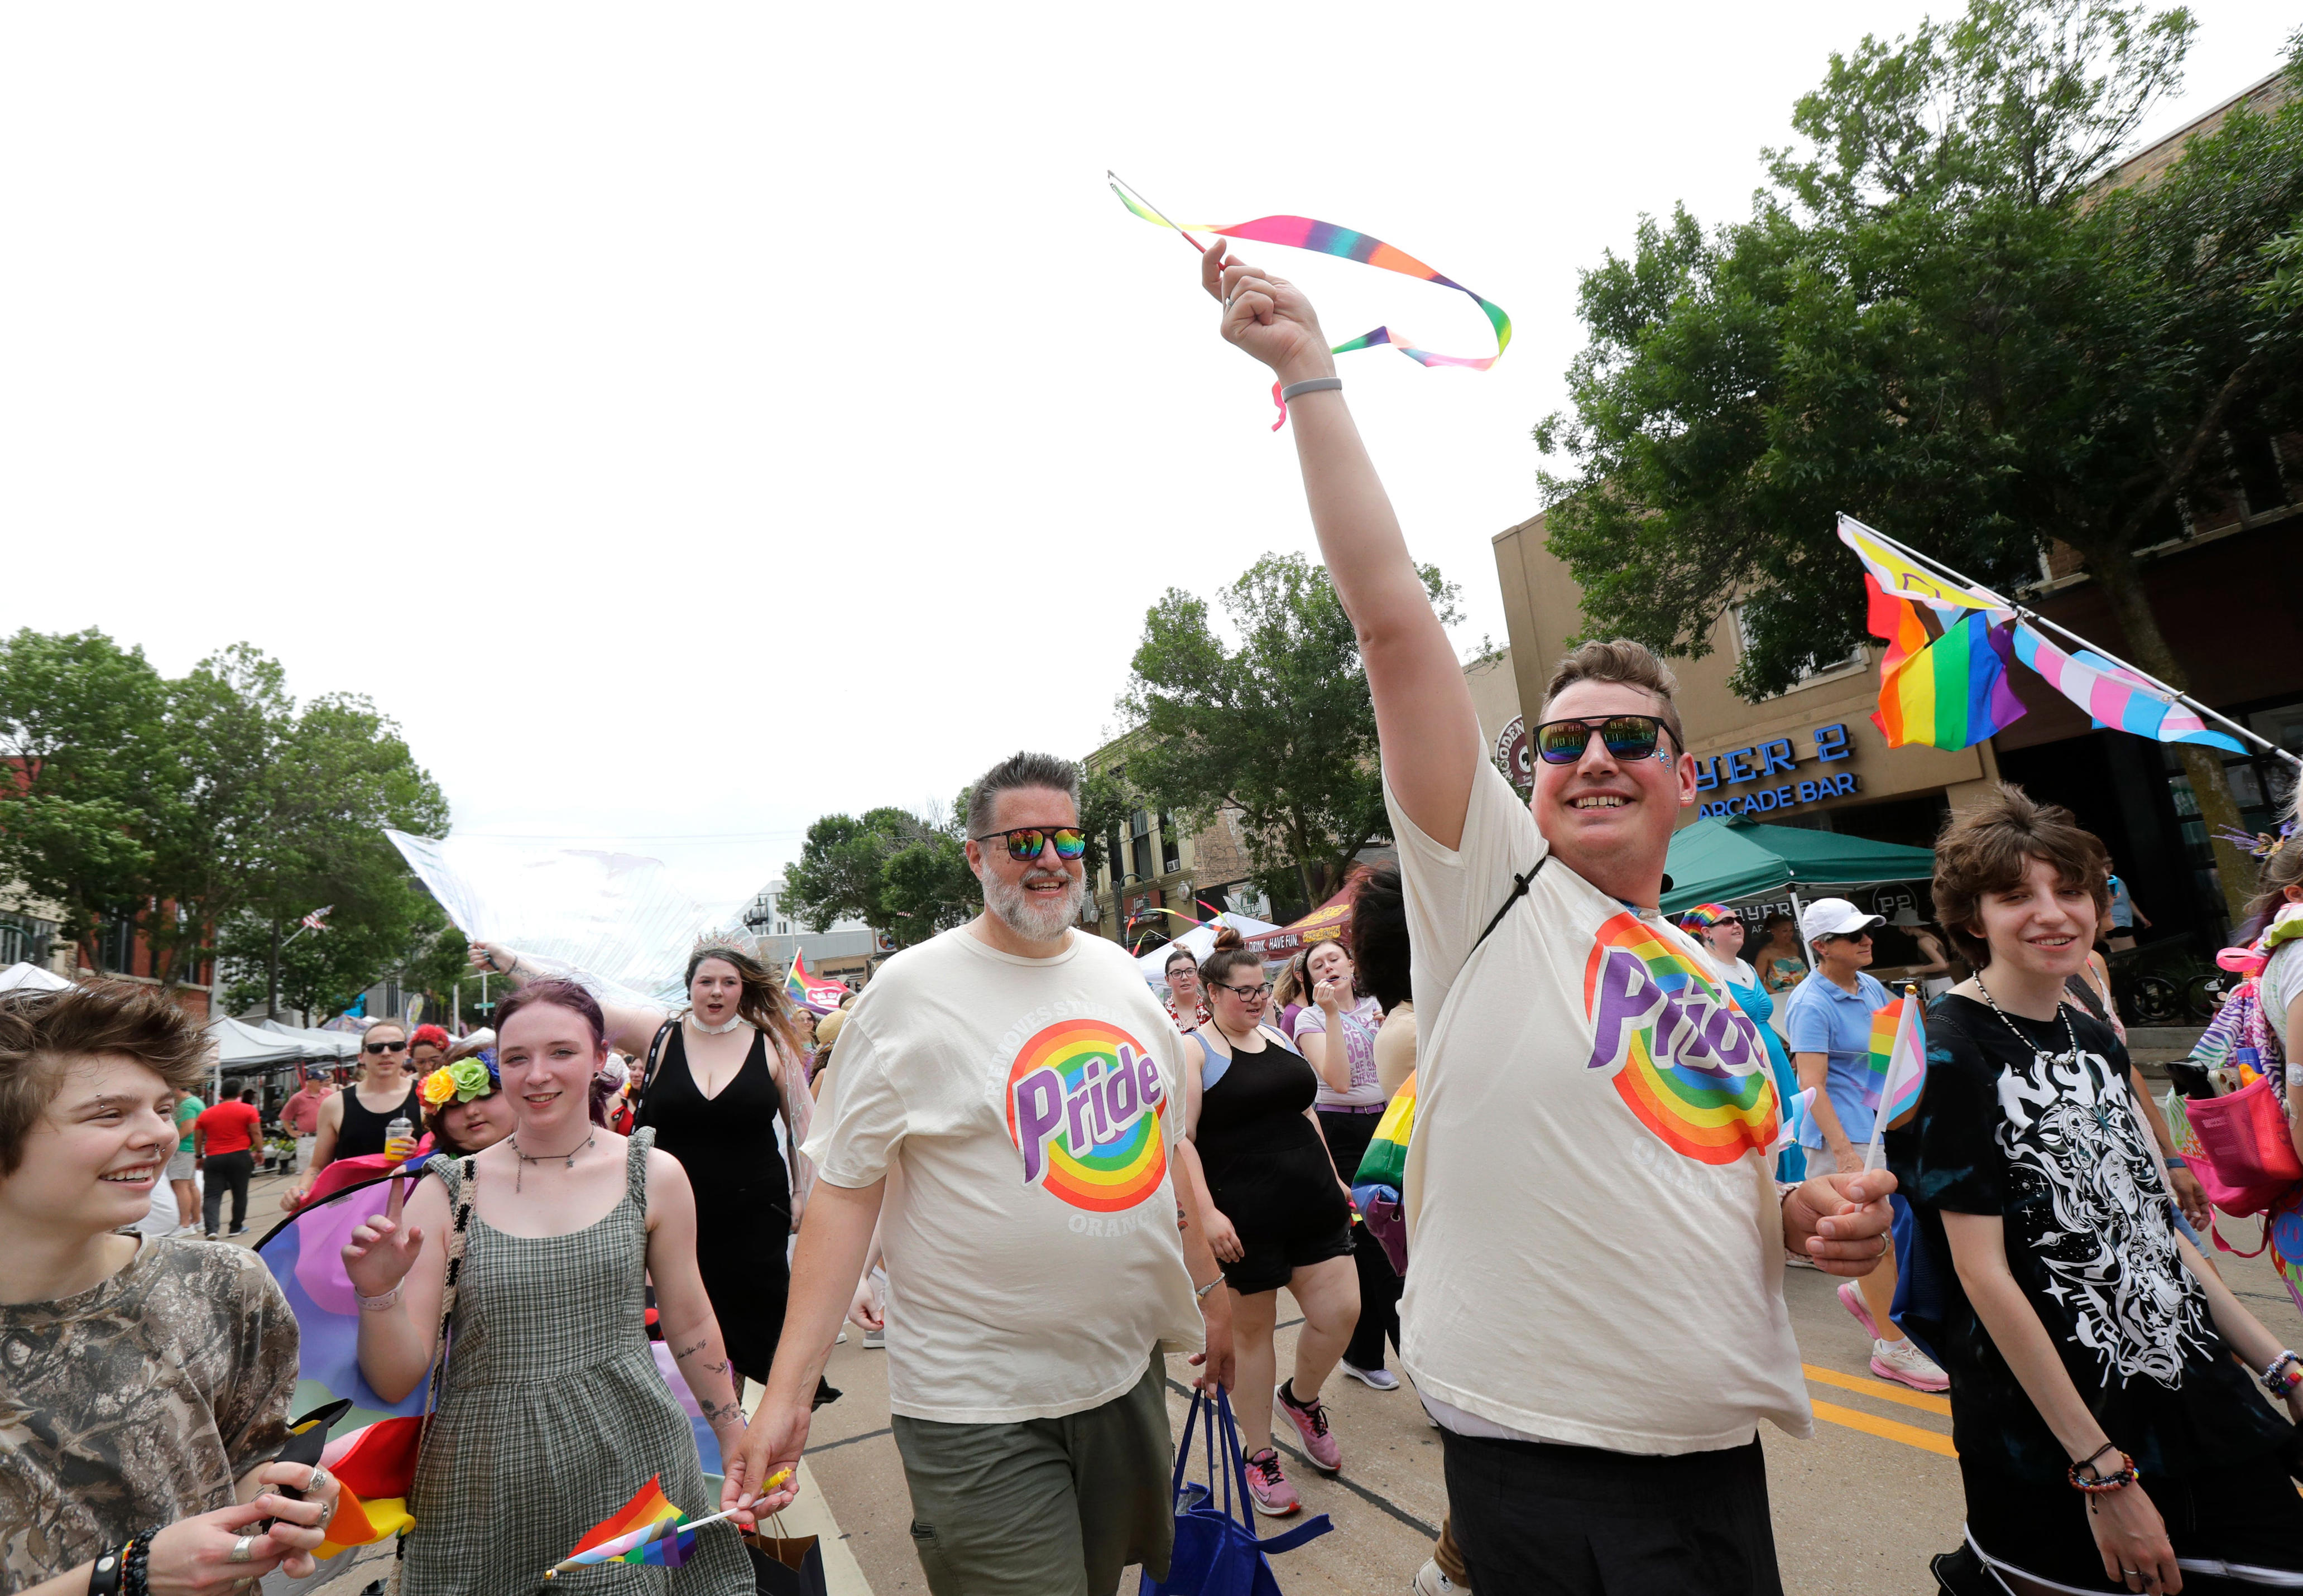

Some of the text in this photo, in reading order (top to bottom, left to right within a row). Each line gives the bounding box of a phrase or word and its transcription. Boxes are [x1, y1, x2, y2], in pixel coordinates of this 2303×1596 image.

[1813, 723, 1849, 763] 2
[1697, 772, 1856, 821] ARCADE BAR
[1878, 895, 1912, 913] P2
[1269, 935, 1284, 950] HAVE
[1285, 934, 1299, 948] FUN.
[983, 1005, 1052, 1097] REMOVES
[1014, 1044, 1163, 1186] Pride
